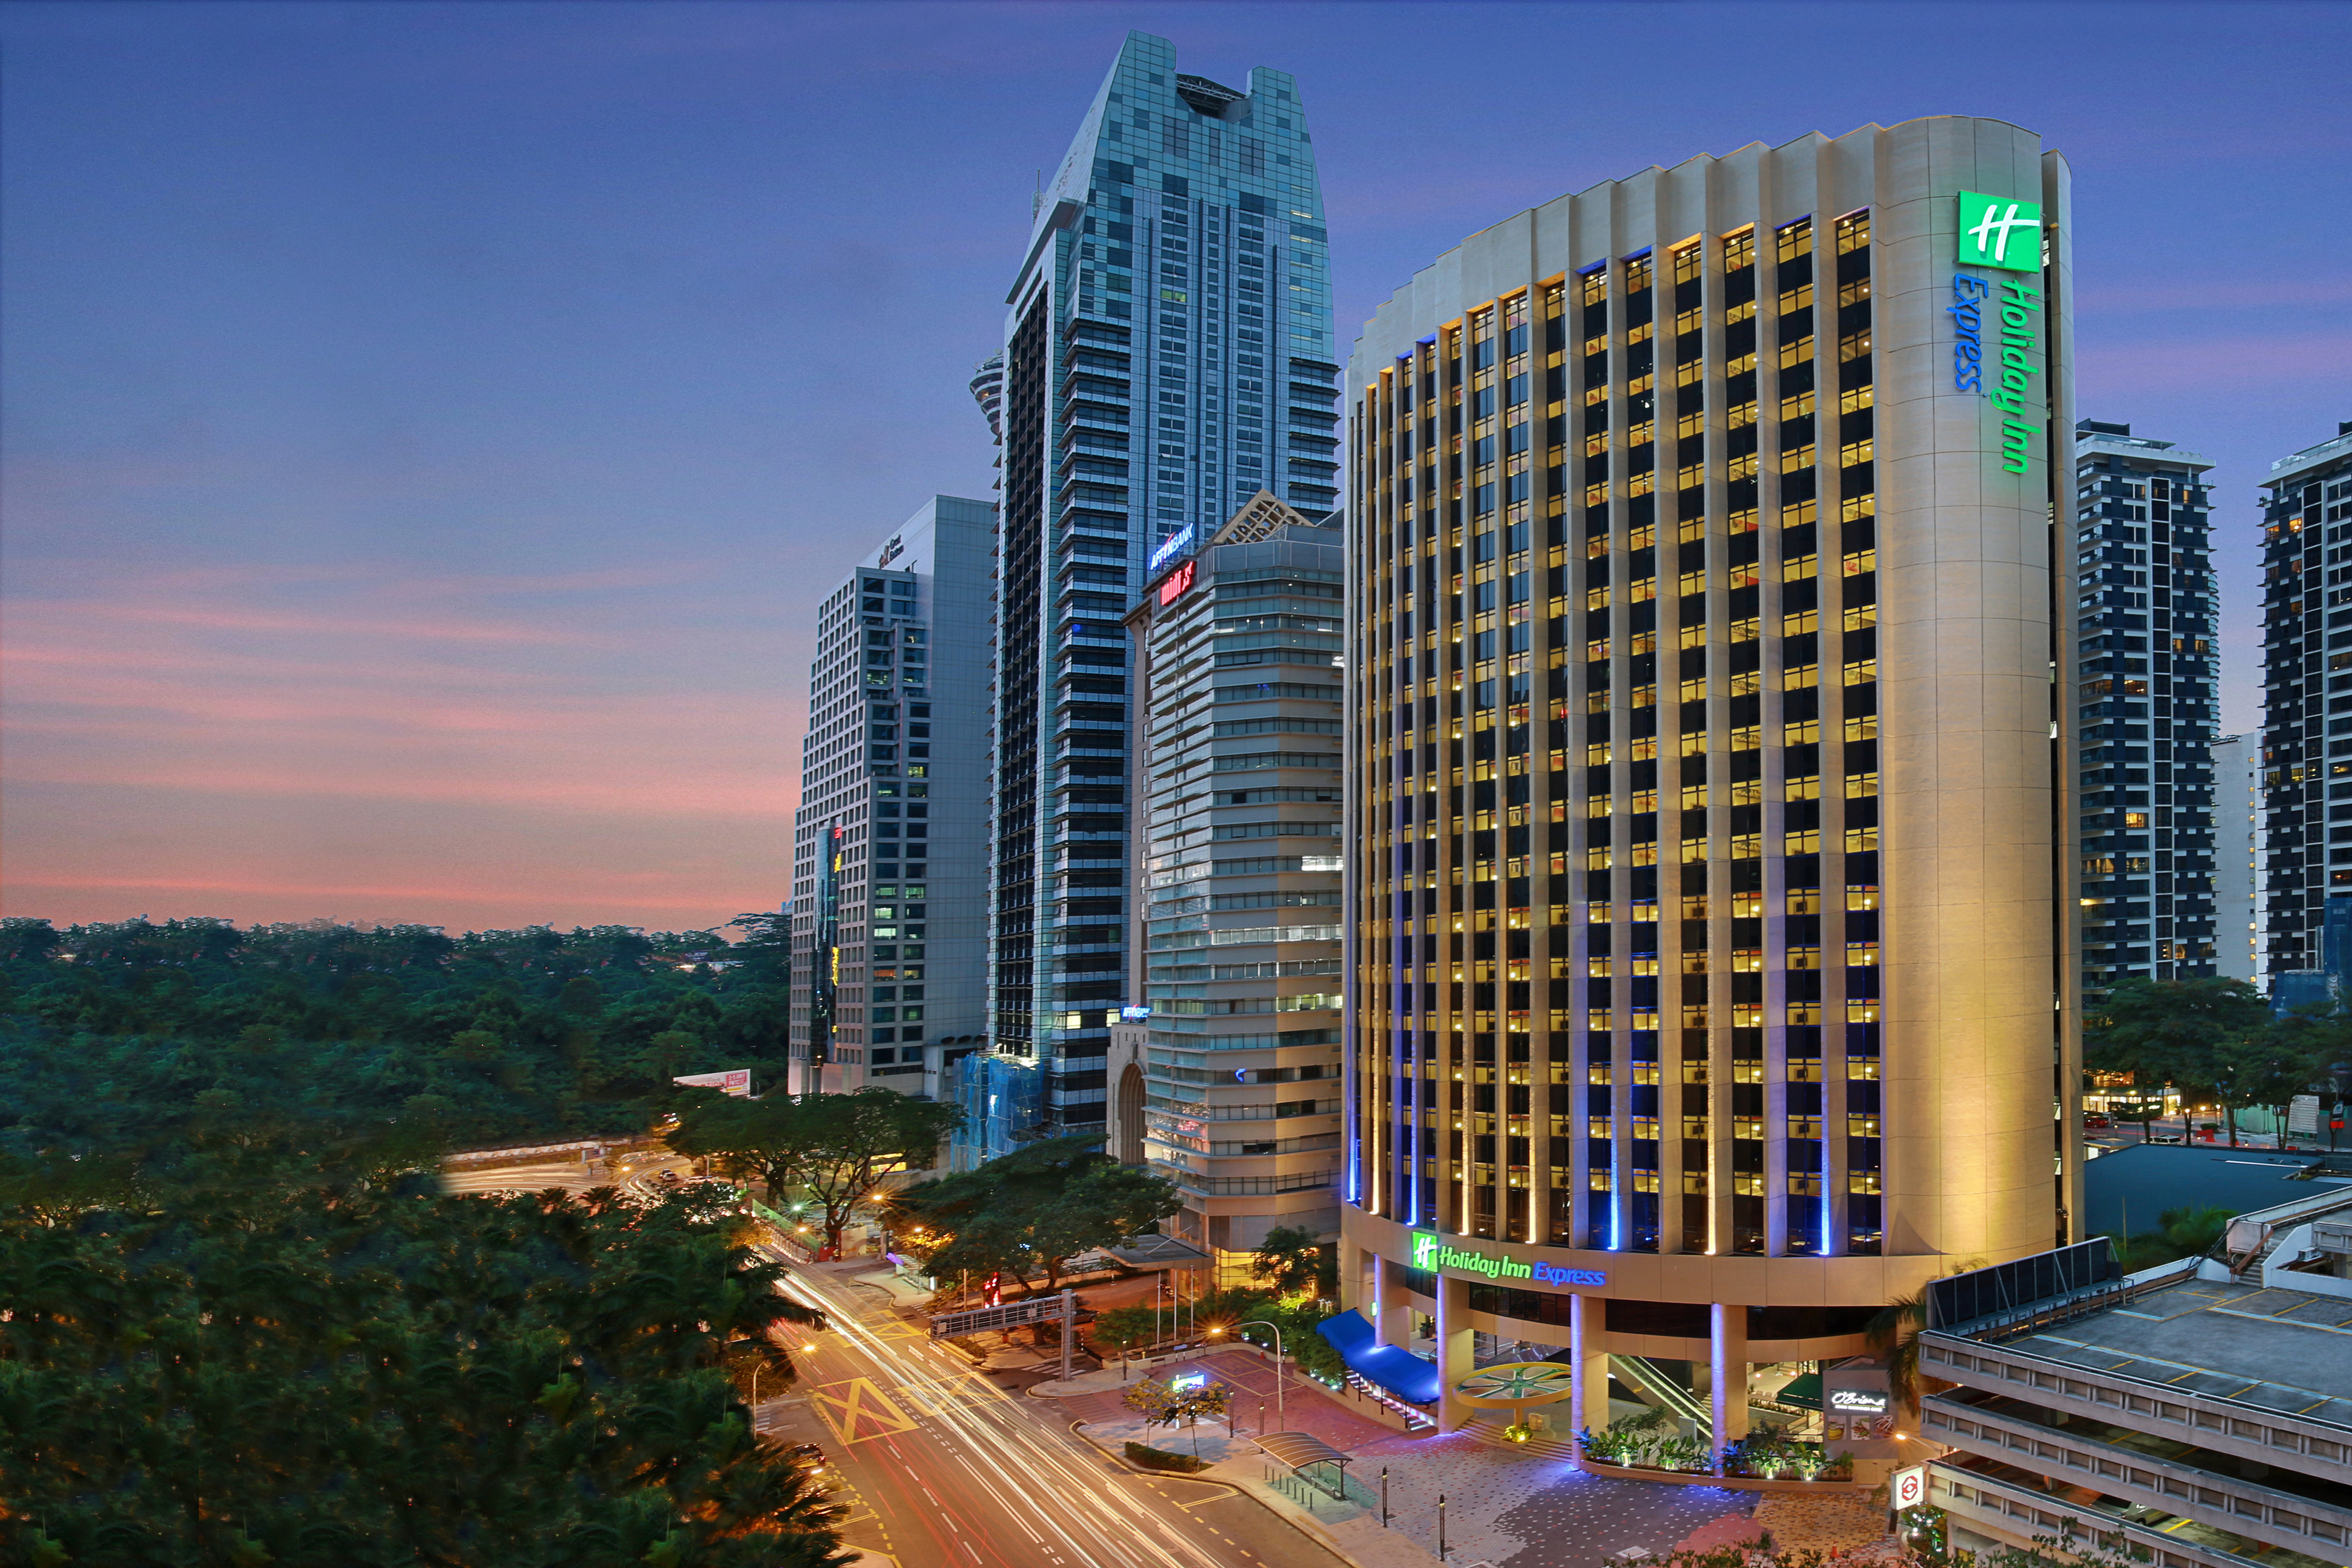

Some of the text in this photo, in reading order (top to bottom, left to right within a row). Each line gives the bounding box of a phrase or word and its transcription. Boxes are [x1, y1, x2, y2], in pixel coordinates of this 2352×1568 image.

[1946, 273, 1989, 392] Express
[1990, 278, 2041, 474] Holiday Inn
[1150, 522, 1194, 570] AFFINBANK
[1439, 1245, 1606, 1287] Holiday Inn Express
